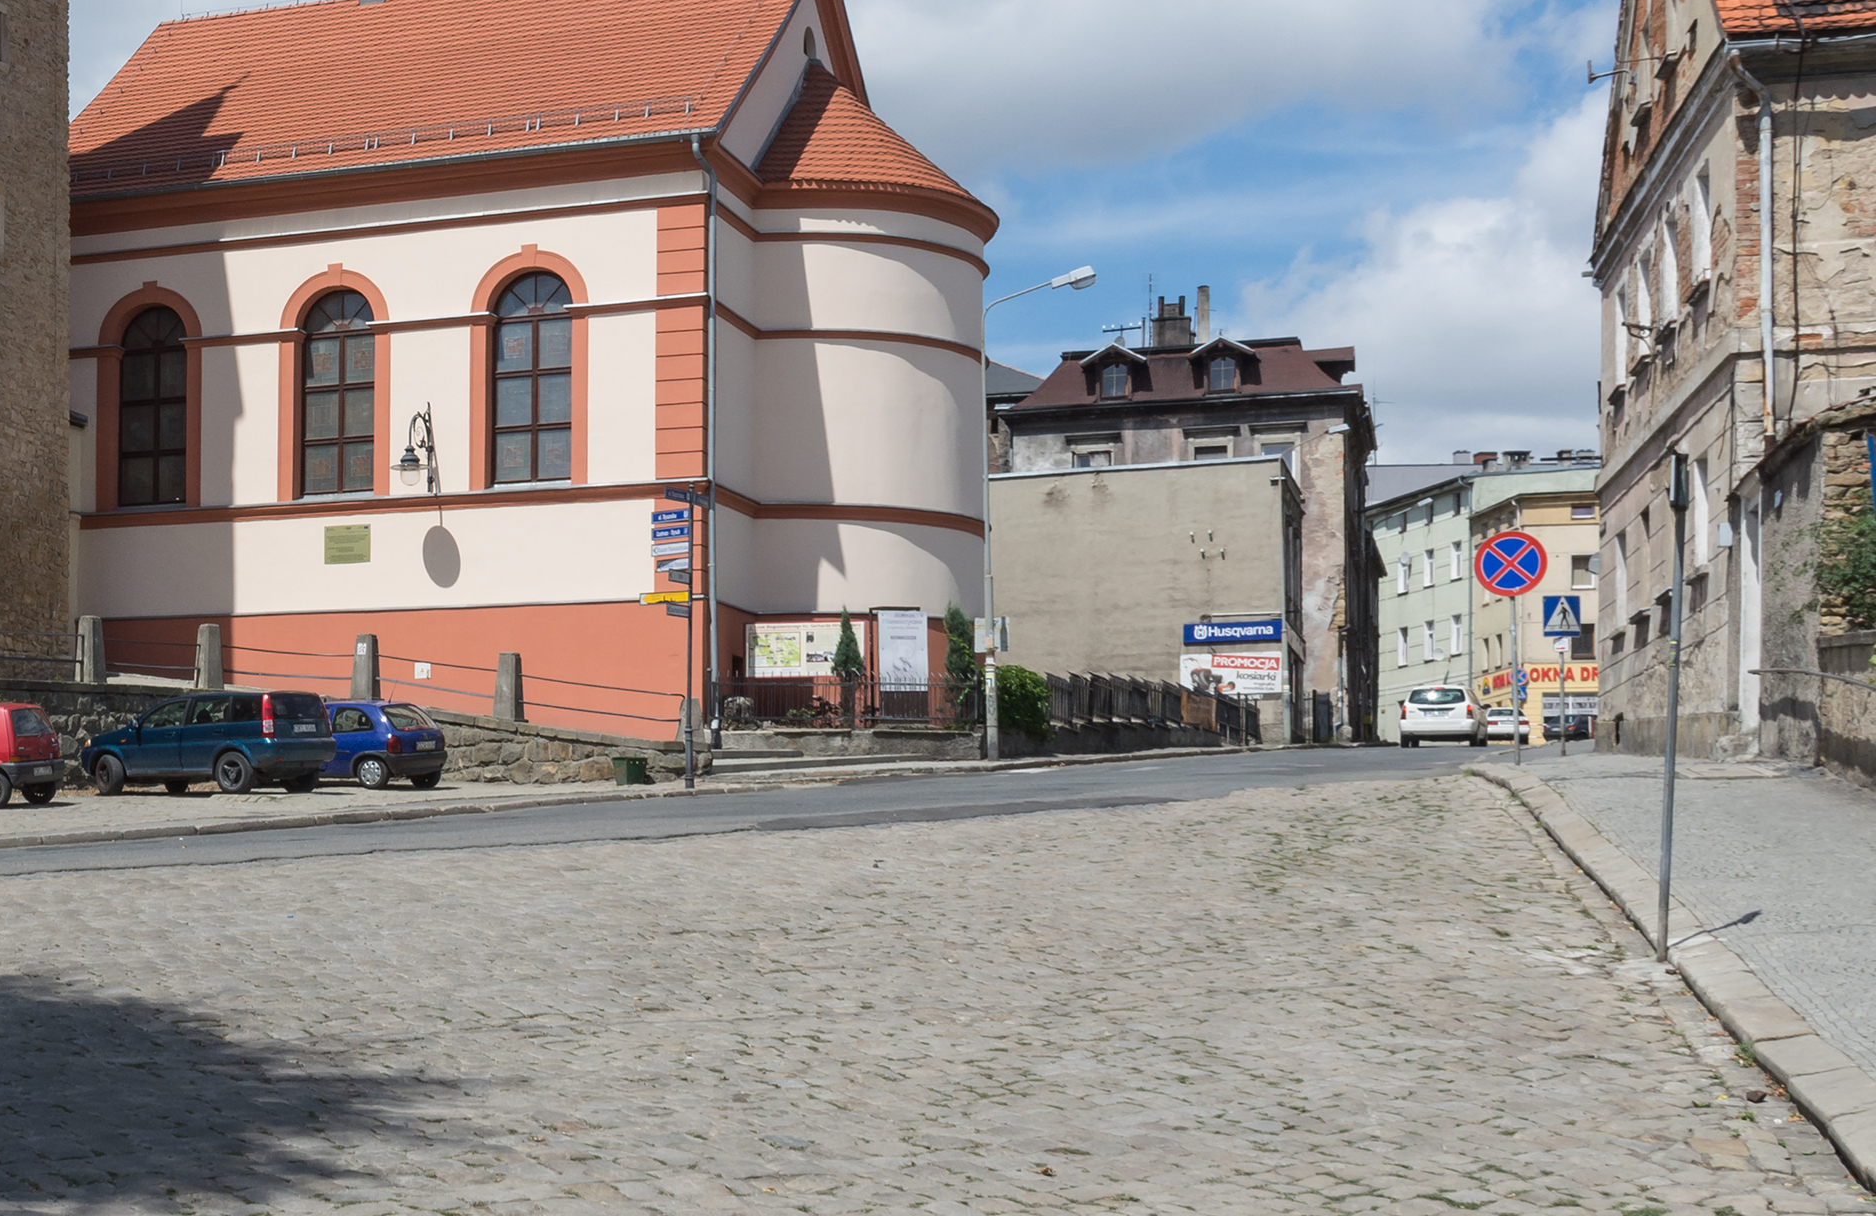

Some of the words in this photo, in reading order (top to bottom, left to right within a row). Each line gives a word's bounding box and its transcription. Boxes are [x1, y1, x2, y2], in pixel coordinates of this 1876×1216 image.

[1208, 625, 1274, 638] Husqvarna
[1213, 656, 1278, 670] PROMOCJA
[1236, 671, 1277, 681] kosiarki
